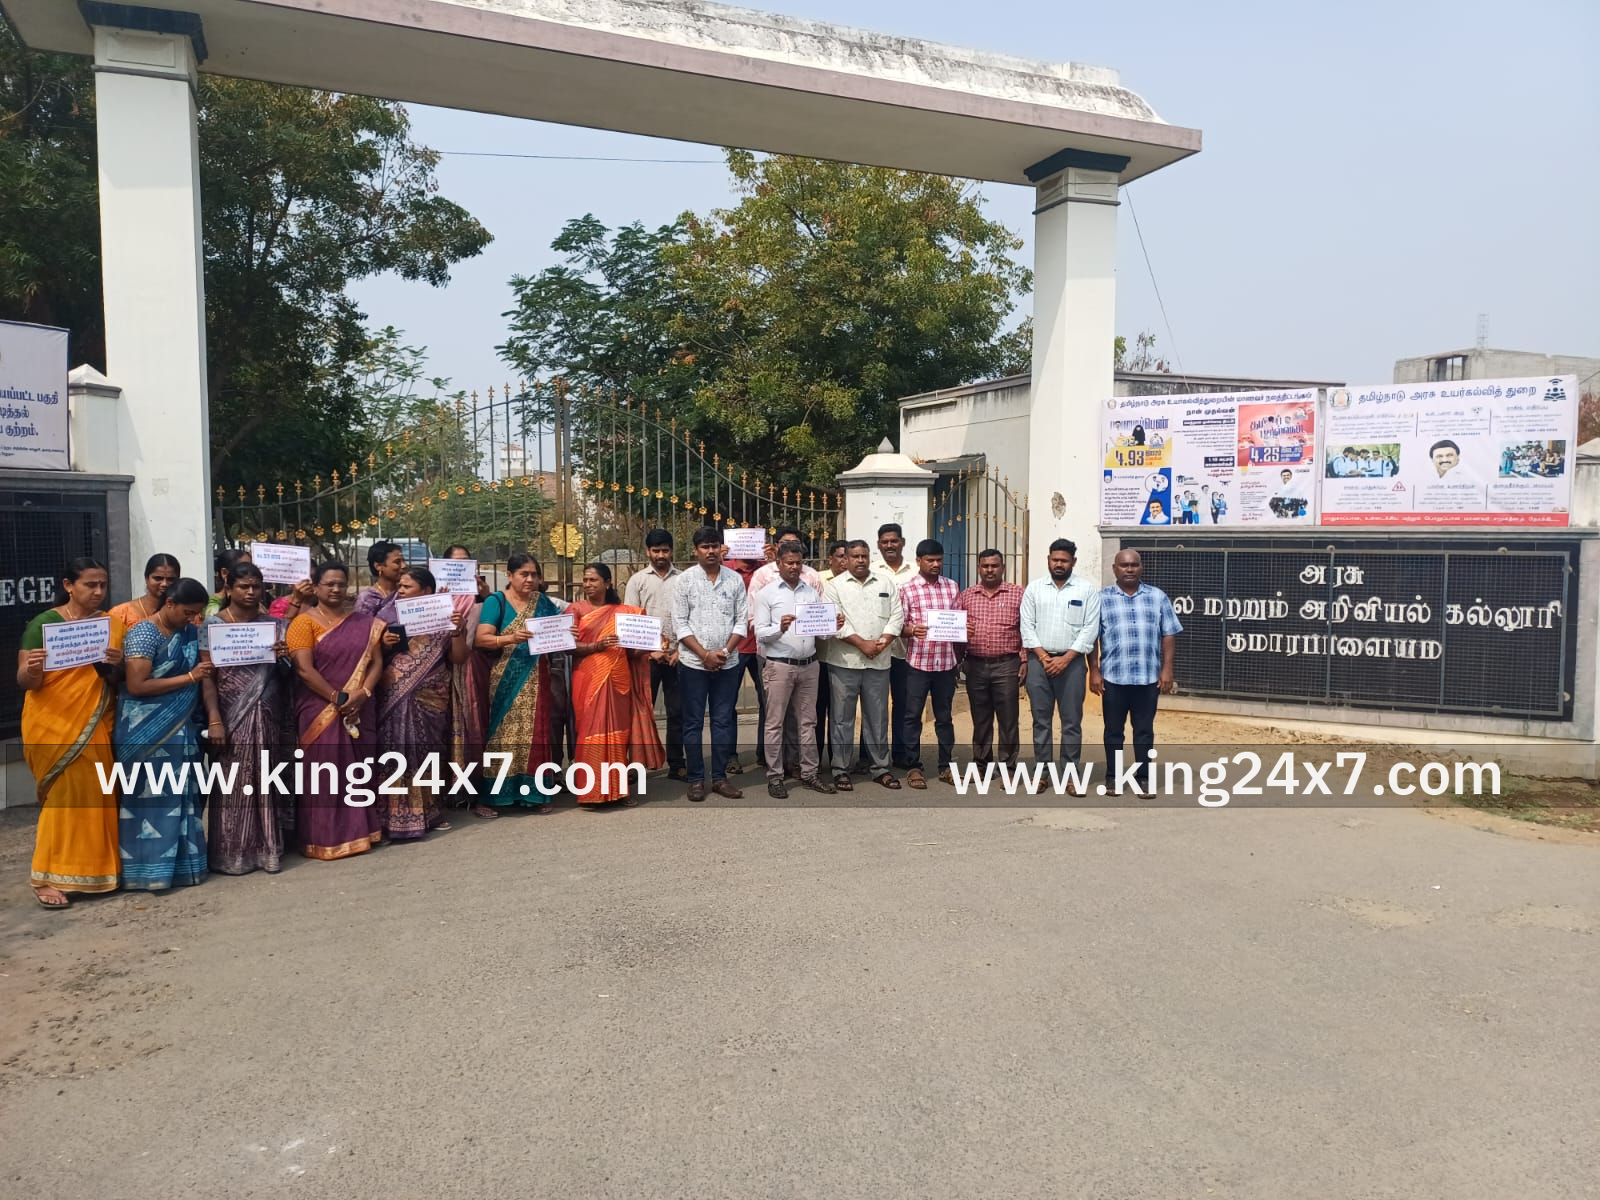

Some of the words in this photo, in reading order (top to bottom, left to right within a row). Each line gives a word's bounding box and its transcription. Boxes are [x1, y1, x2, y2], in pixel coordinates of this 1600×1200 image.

[37, 391, 59, 404] பகுதி
[1358, 389, 1406, 404] தமிழ்நாடு
[1409, 389, 1436, 400] அரசு
[1505, 385, 1537, 398] துறை
[1115, 450, 1144, 466] 4.93
[1251, 447, 1280, 462] 4.25
[1299, 564, 1364, 588] அரசு
[1299, 594, 1431, 625] அறிவியல்
[1445, 598, 1563, 631] கல்லூரி
